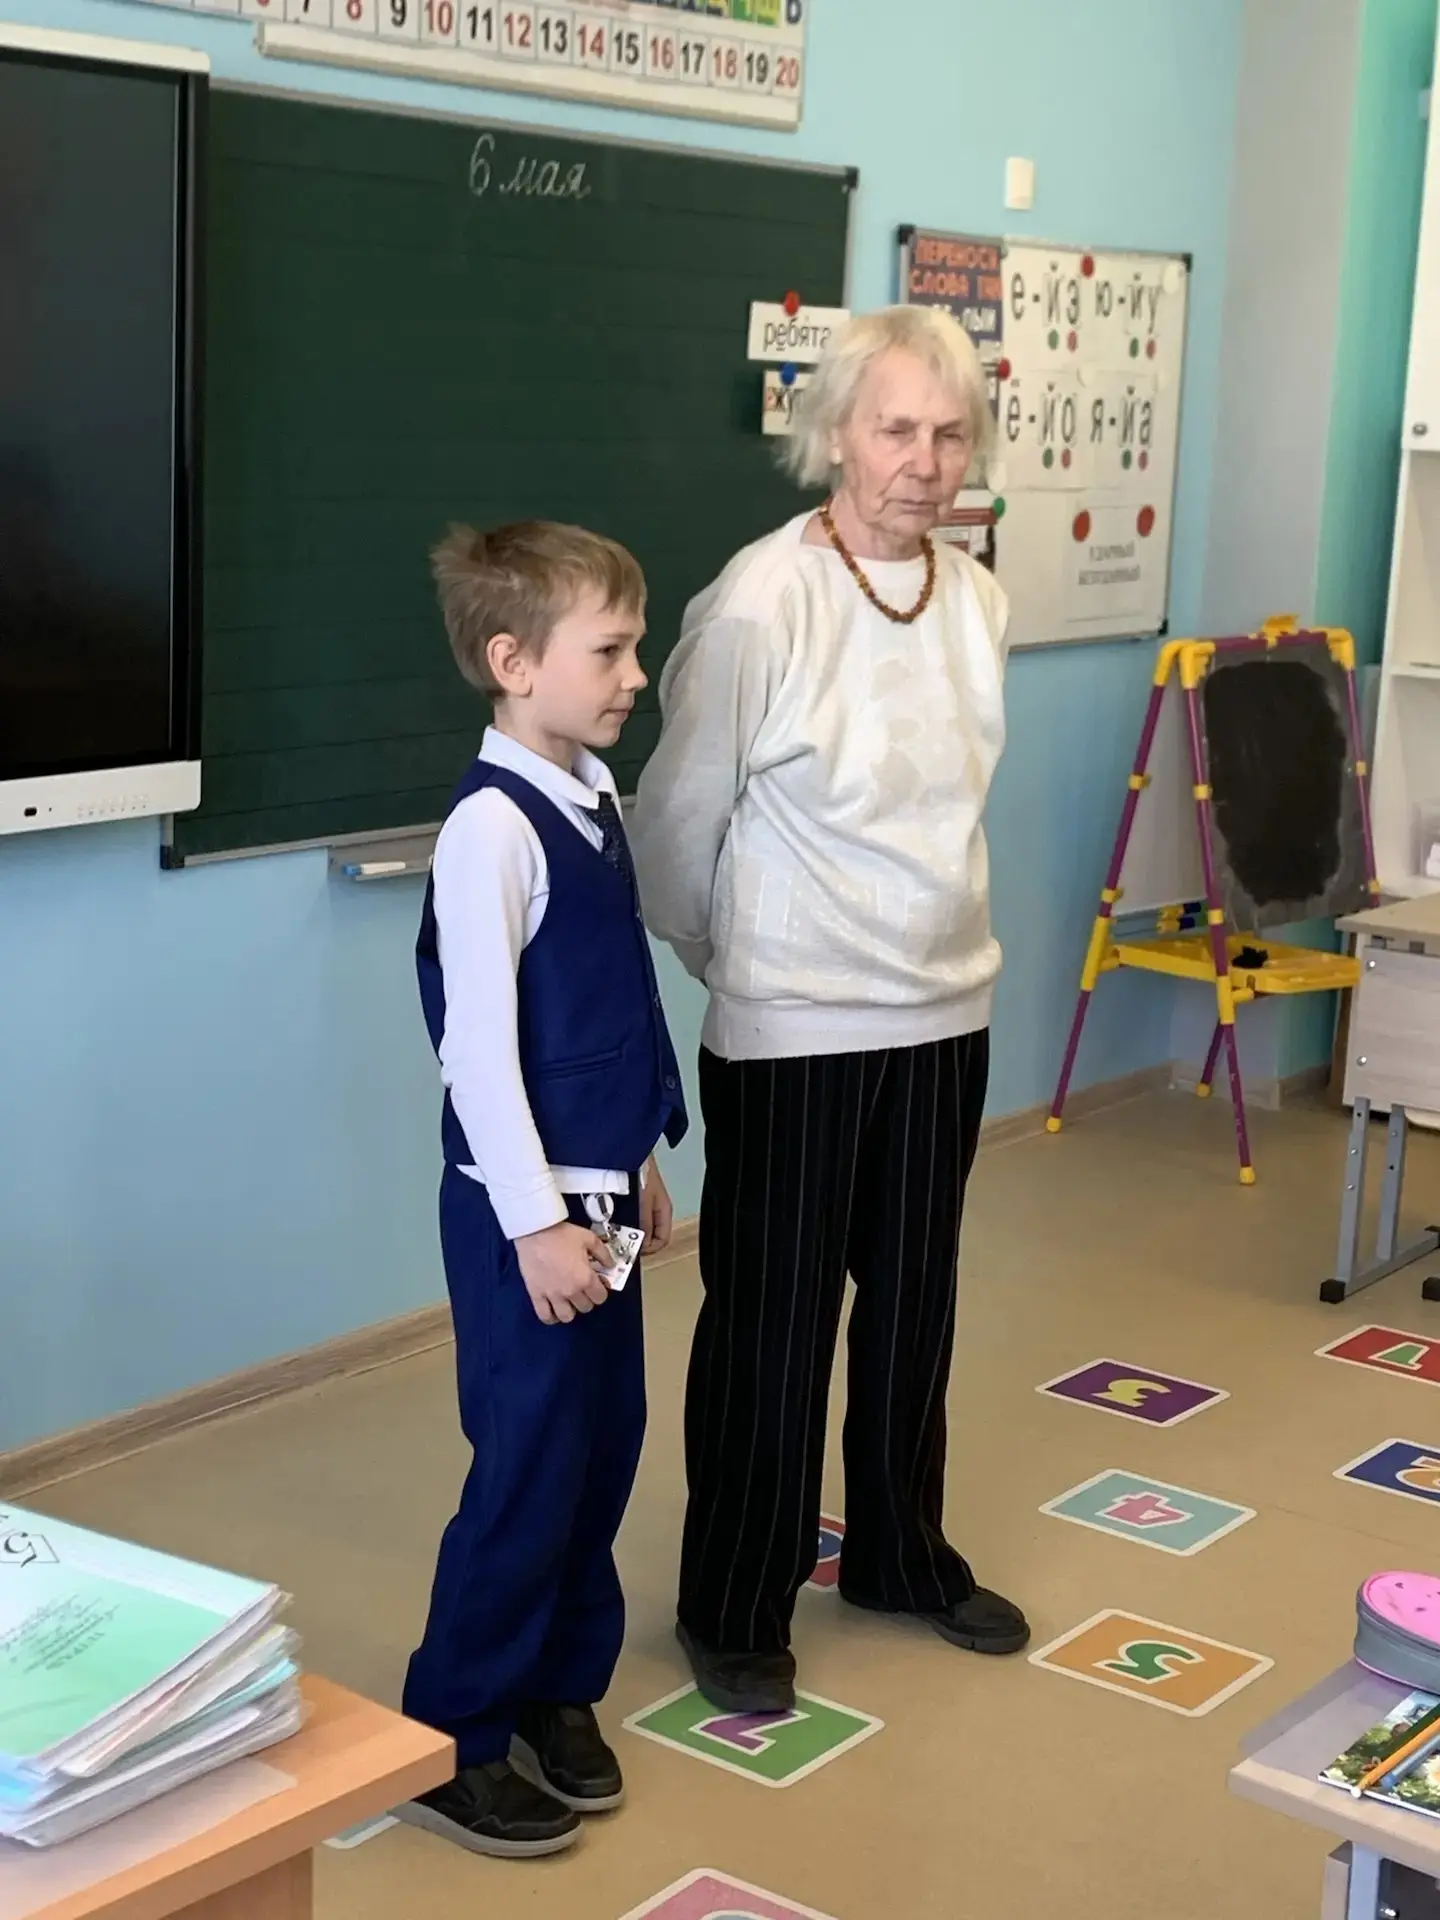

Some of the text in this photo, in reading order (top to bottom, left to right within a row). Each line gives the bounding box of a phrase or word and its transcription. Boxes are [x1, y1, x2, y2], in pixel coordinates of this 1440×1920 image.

[391, 0, 408, 28] 9
[425, 0, 455, 36] 10
[467, 5, 494, 42] 11
[504, 11, 532, 48] 12
[540, 17, 568, 54] 13
[577, 23, 606, 59] 14
[614, 29, 640, 65] 15
[650, 36, 674, 71] 16
[681, 41, 706, 75] 17
[714, 46, 738, 80] 18
[746, 51, 770, 85] 19
[776, 55, 800, 89] 20
[469, 131, 593, 199] 6 мая
[1091, 1378, 1172, 1408] 3
[1094, 1491, 1196, 1530] 4
[1091, 1640, 1207, 1684] 5
